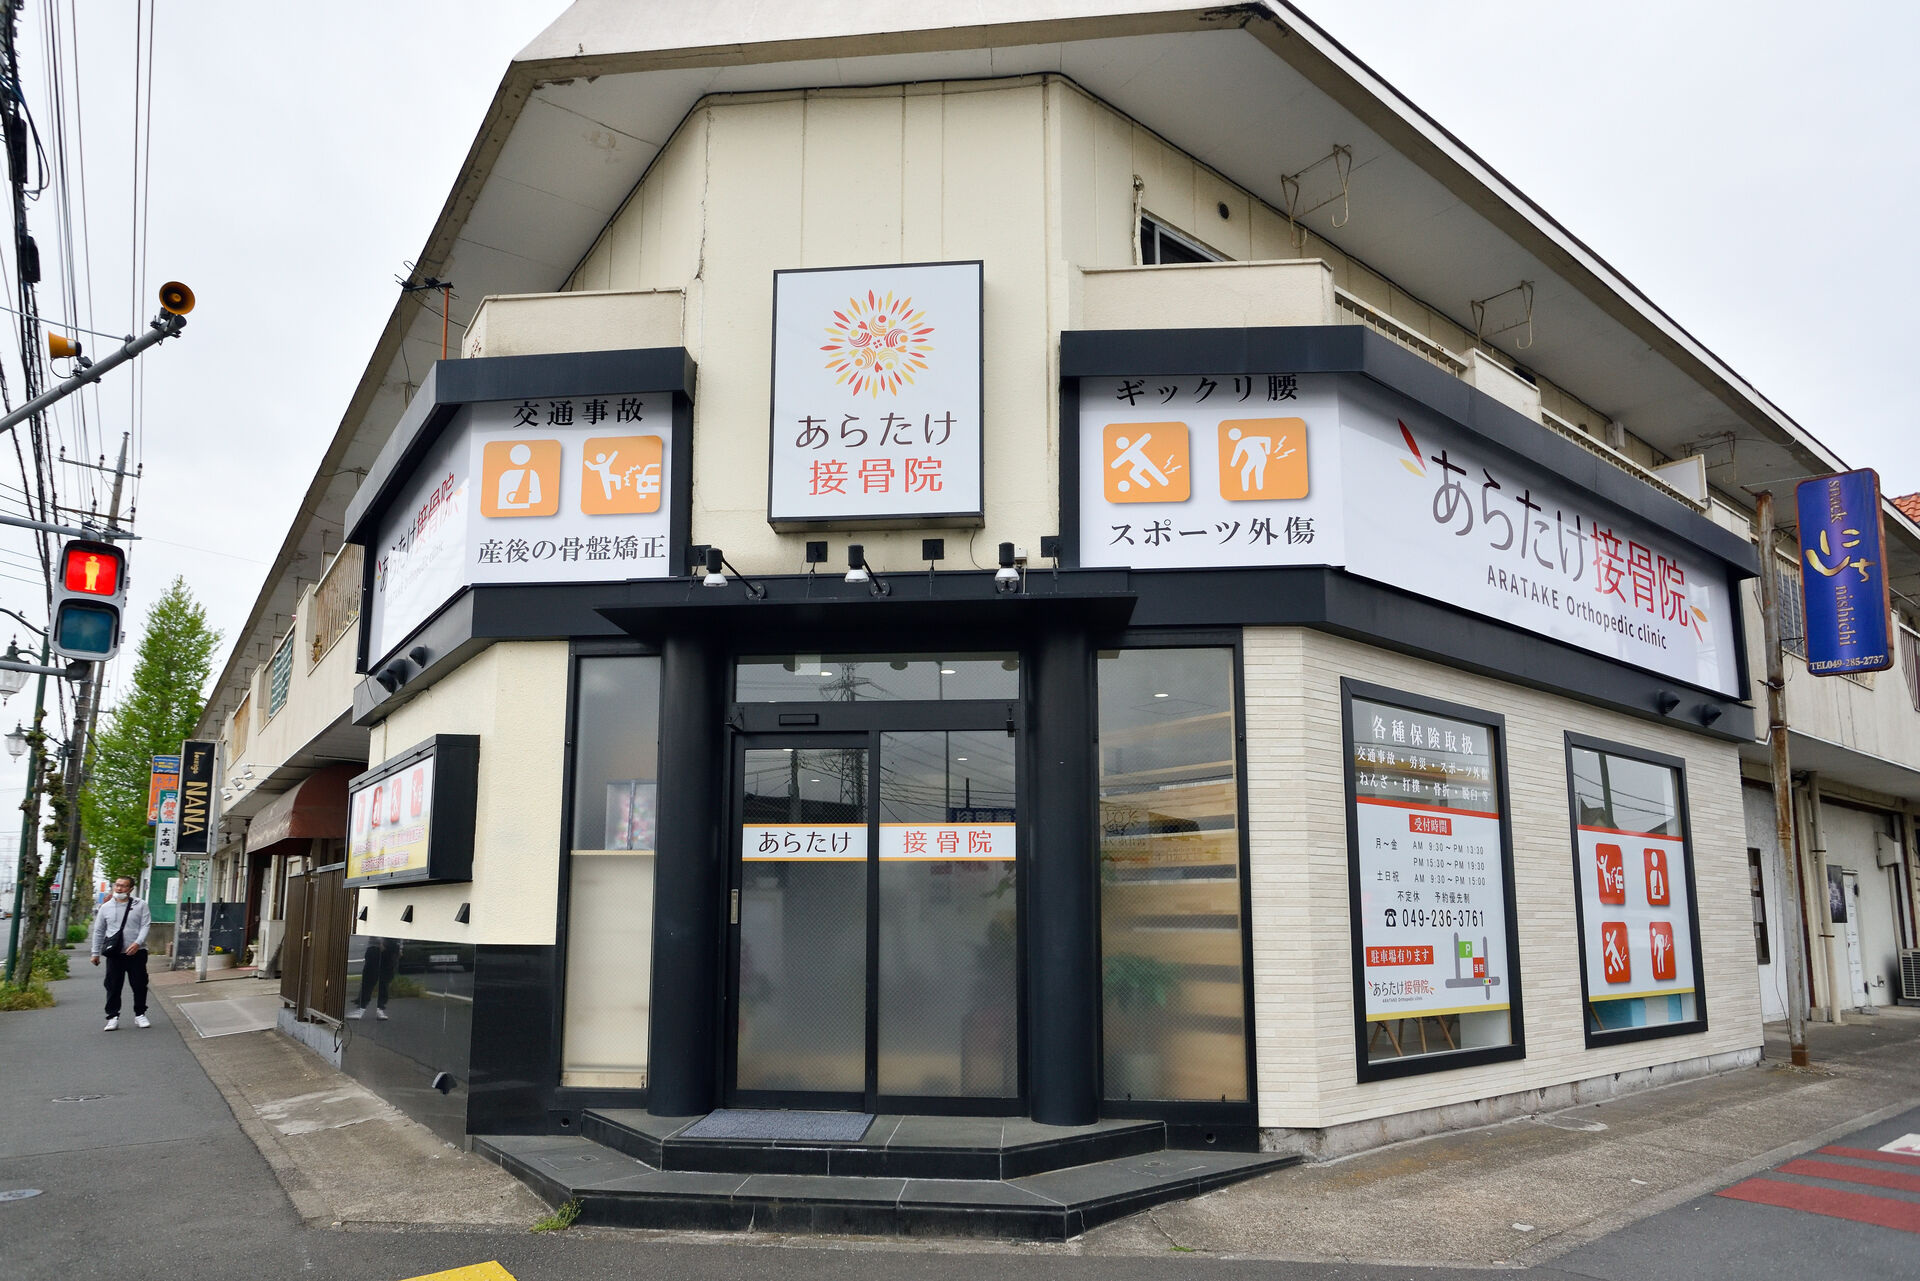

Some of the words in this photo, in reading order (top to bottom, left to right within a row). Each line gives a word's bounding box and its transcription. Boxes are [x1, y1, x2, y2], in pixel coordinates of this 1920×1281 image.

[1116, 373, 1299, 406] ギックリ腰
[513, 397, 644, 428] 交通事故
[795, 410, 958, 450] あらたけ
[809, 456, 943, 496] 接骨院
[1828, 480, 1847, 524] snack
[1109, 516, 1316, 547] スポーツ外傷
[477, 535, 667, 565] 産後の骨盤矯正
[1487, 565, 1559, 610] ARATAKE
[1567, 596, 1635, 638] Orthopedic
[1637, 622, 1667, 650] clinic
[1835, 585, 1857, 647] nishichi
[1372, 714, 1474, 756] 各種保険取扱
[182, 781, 208, 836] NANA
[1414, 817, 1448, 834] 受付時間
[758, 831, 852, 854] あらたけ
[903, 830, 993, 854] 接骨院
[1377, 870, 1399, 883] 土日祝
[1397, 890, 1420, 903] 不定休
[1402, 908, 1484, 927] 049-236-3761
[1370, 948, 1430, 964] 駐車場有ります
[1465, 943, 1471, 955] P
[1373, 979, 1430, 997] あらたけ接骨院
